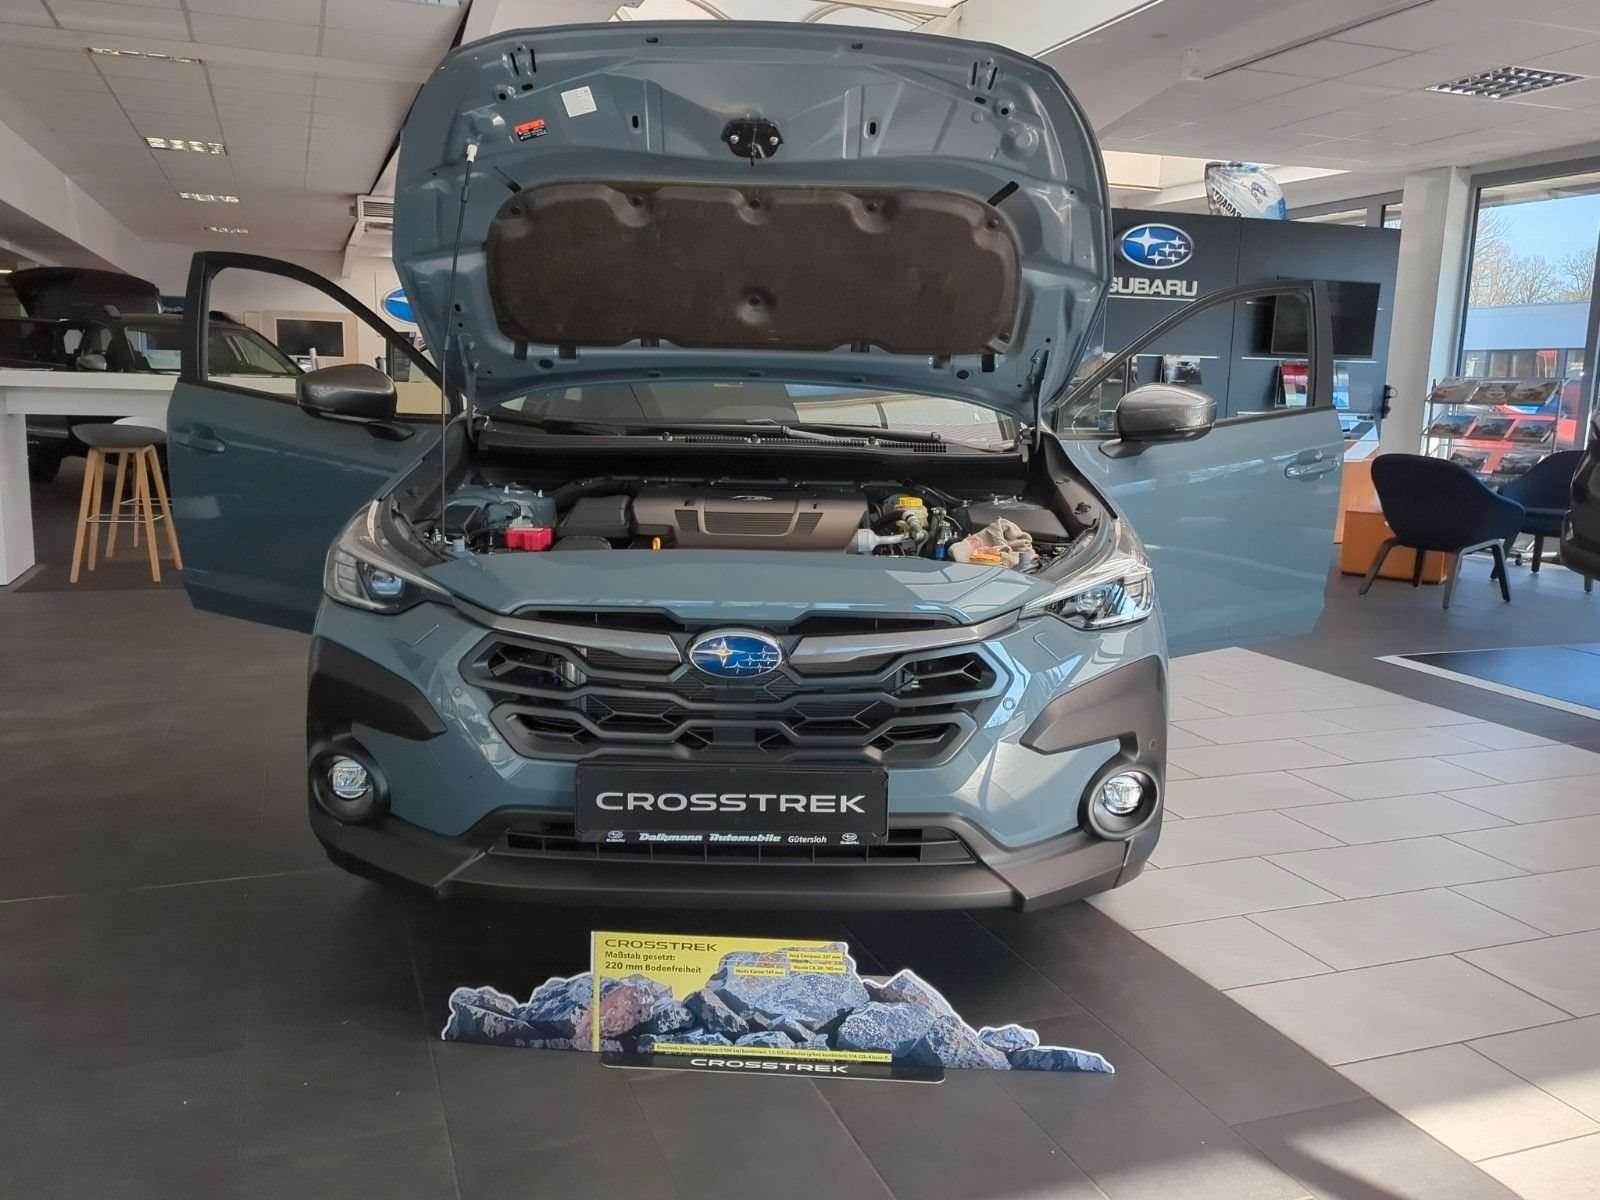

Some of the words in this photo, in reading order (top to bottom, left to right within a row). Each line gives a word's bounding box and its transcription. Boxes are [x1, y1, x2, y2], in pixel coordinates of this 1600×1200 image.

[595, 791, 866, 814] CROSSTREK
[604, 938, 719, 952] CROSSTREK
[604, 951, 641, 960] Maßstab
[642, 953, 677, 962] gesetzt:
[604, 961, 623, 970] 220
[645, 964, 702, 974] Bodenfreiheit
[690, 1058, 849, 1074] CROSSTREK
